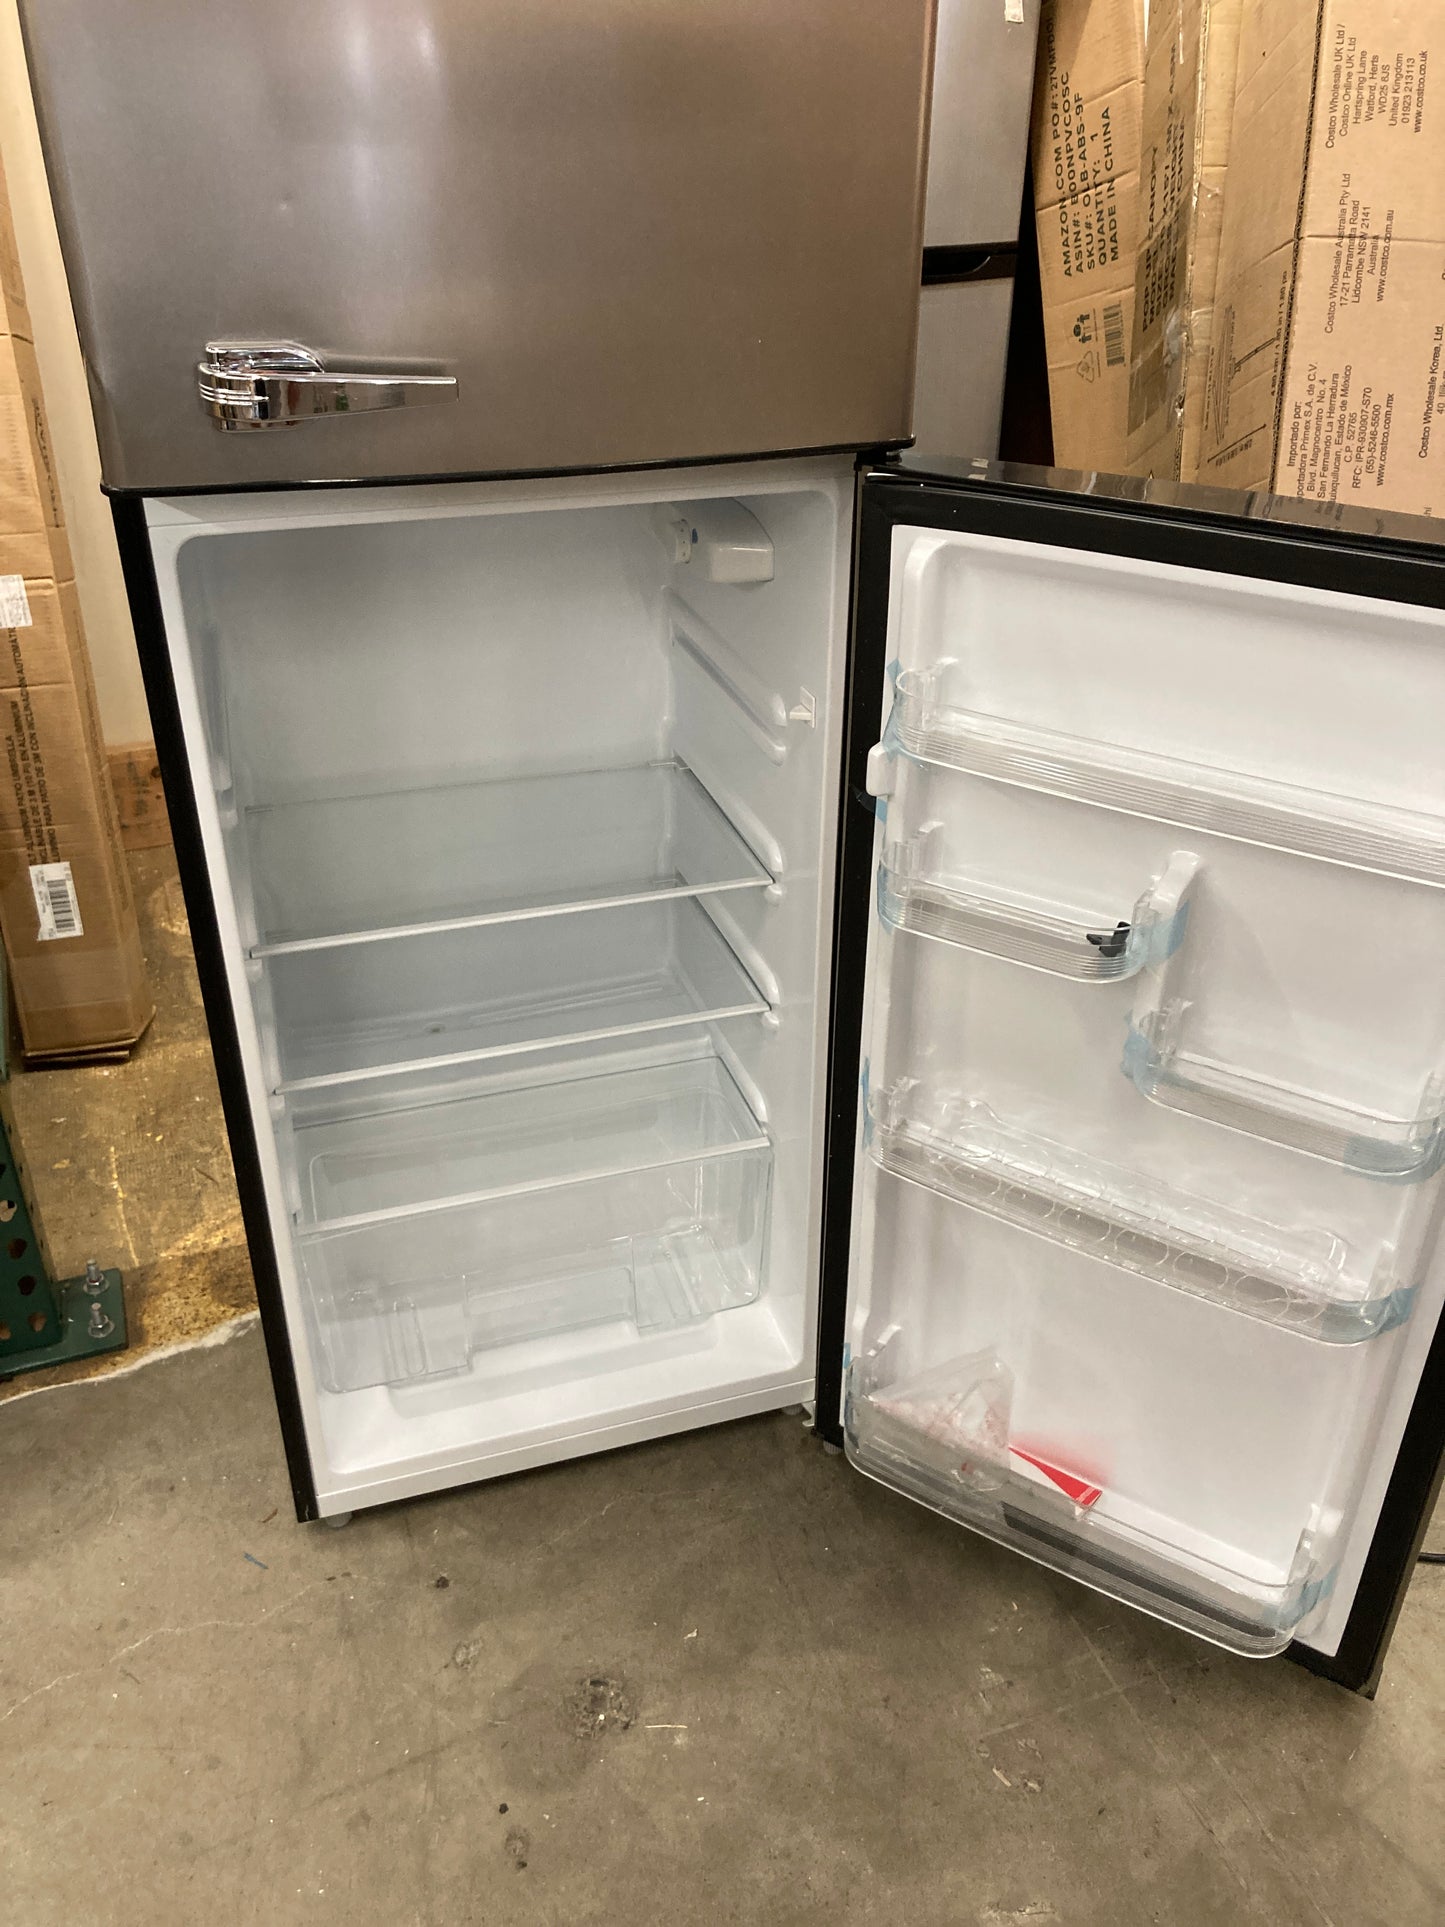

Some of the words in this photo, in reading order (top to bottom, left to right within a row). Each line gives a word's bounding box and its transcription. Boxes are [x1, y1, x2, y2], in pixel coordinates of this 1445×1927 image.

[1336, 30, 1345, 45] Ltd
[1347, 37, 1356, 51] Ltd
[1334, 47, 1344, 62] UK
[1345, 54, 1355, 69] UK
[1358, 50, 1367, 74] Lane
[1369, 55, 1379, 80] Herts
[1343, 71, 1353, 101] Online
[1381, 64, 1390, 82] 8JS
[1391, 53, 1404, 94] Kingdom
[1404, 58, 1415, 92] 213113
[1329, 65, 1342, 113] Wholesale
[1352, 76, 1366, 124] Hartspring
[1378, 85, 1388, 114] WD25
[1413, 51, 1427, 133] www.costco.co.uk
[1339, 104, 1350, 136] Costco
[1388, 96, 1399, 126] United
[1401, 95, 1412, 124] 01923
[1090, 133, 1098, 141] 1
[1102, 107, 1113, 171] CHINA
[1325, 116, 1337, 148] Costco
[1074, 92, 1091, 207] OLB-ABS-9F
[1106, 178, 1116, 198] IN
[1147, 147, 1158, 240] CANOPY
[1341, 173, 1351, 187] Ltd
[1054, 147, 1072, 277] AMAZON.COM
[1093, 160, 1107, 265] QUANTITY:
[1339, 190, 1350, 205] Pty
[1350, 200, 1360, 224] Road
[1335, 208, 1347, 248] Australia
[1360, 206, 1371, 229] 2141
[1072, 211, 1083, 273] ASIN#:
[1084, 214, 1095, 270] SKU#:
[1108, 205, 1119, 261] MADE
[1357, 231, 1368, 255] NSW
[1145, 249, 1151, 279] UP
[1342, 227, 1357, 278] Parramatta
[1367, 235, 1379, 275] Australia
[1376, 210, 1394, 302] www.costco.com.au
[1329, 251, 1342, 299] Wholesale
[1352, 258, 1364, 303] Lidcombe
[1339, 282, 1350, 306] 17-21
[1324, 301, 1336, 333] Costco
[1433, 324, 1444, 341] Ltd.
[1307, 362, 1318, 381] C.V.
[1429, 344, 1442, 374] Korea,
[1306, 384, 1315, 395] de
[1317, 389, 1326, 403] No.
[1326, 373, 1339, 418] Herradura
[1339, 365, 1352, 397] México
[1292, 401, 1303, 419] por:
[1304, 398, 1314, 417] S.A.
[1337, 400, 1347, 411] de
[1423, 377, 1437, 424] Wholesale
[1301, 420, 1311, 451] Primex
[1310, 408, 1323, 466] Magnocentro
[1323, 421, 1333, 432] La
[1335, 414, 1346, 445] Estado
[1346, 412, 1357, 440] 52765
[1365, 404, 1381, 474] (55)-5246-5500
[1376, 393, 1394, 486] www.costco.com.mx
[1286, 421, 1300, 466] Importado
[1320, 436, 1332, 478] Fernando
[1418, 426, 1431, 458] Costco
[1296, 454, 1307, 496] portadora
[1307, 470, 1317, 491] Blvd.
[1329, 448, 1343, 500] uixquilucan,
[1352, 465, 1363, 488] RFC:
[1317, 481, 1327, 498] San
[7, 627, 24, 675] AUTOMÁTIC
[20, 750, 29, 761] EN
[28, 732, 39, 751] CON
[5, 735, 20, 780] UMBRELLA
[33, 752, 41, 764] 3M
[35, 766, 45, 778] DE
[14, 782, 24, 806] PATIO
[38, 779, 49, 803] PATIO
[30, 804, 39, 816] DE
[43, 805, 52, 826] PARA
[33, 818, 48, 863] NCLINABLE
[47, 829, 61, 862] LUMINIO
